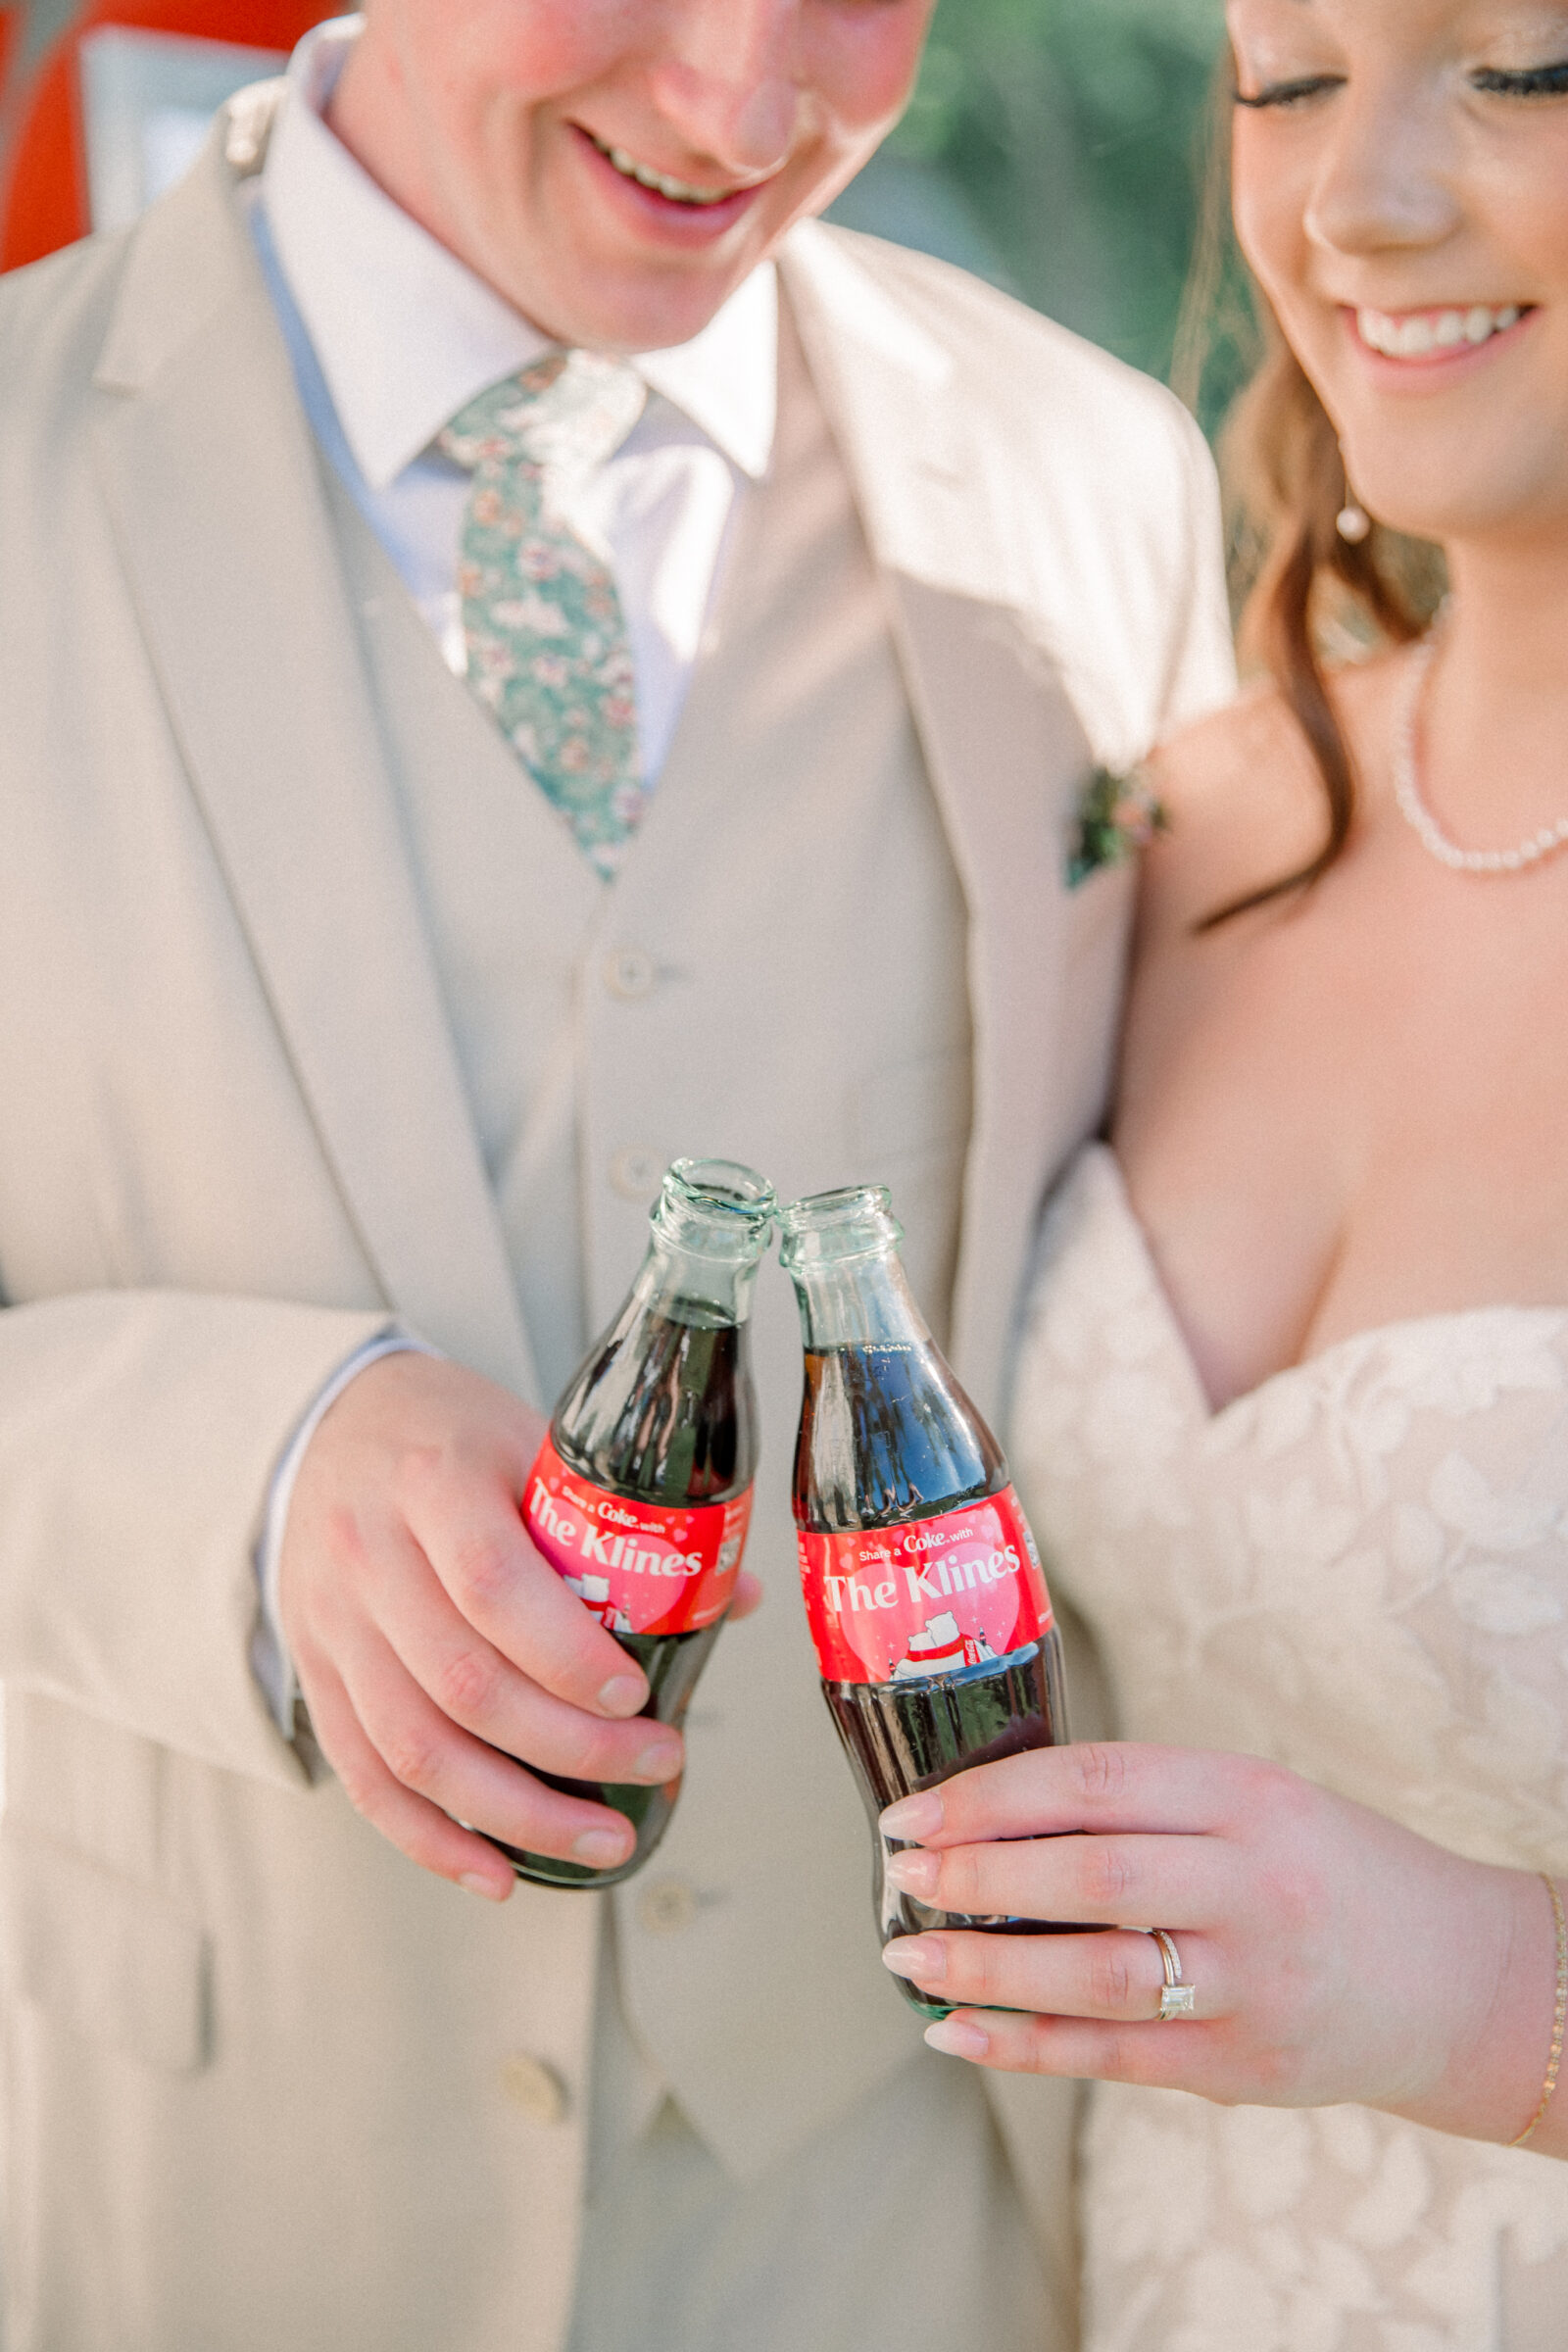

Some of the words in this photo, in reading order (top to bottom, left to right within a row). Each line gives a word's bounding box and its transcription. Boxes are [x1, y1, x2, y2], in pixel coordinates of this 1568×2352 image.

[529, 1476, 576, 1546] The
[580, 1523, 703, 1577] Klines
[598, 1501, 638, 1528] Coke
[640, 1522, 665, 1534] with
[858, 1548, 892, 1562] Share
[894, 1547, 903, 1556] a
[904, 1532, 946, 1553] Coke
[950, 1527, 974, 1542] with
[824, 1576, 899, 1612] The
[904, 1544, 1020, 1603] Klines
